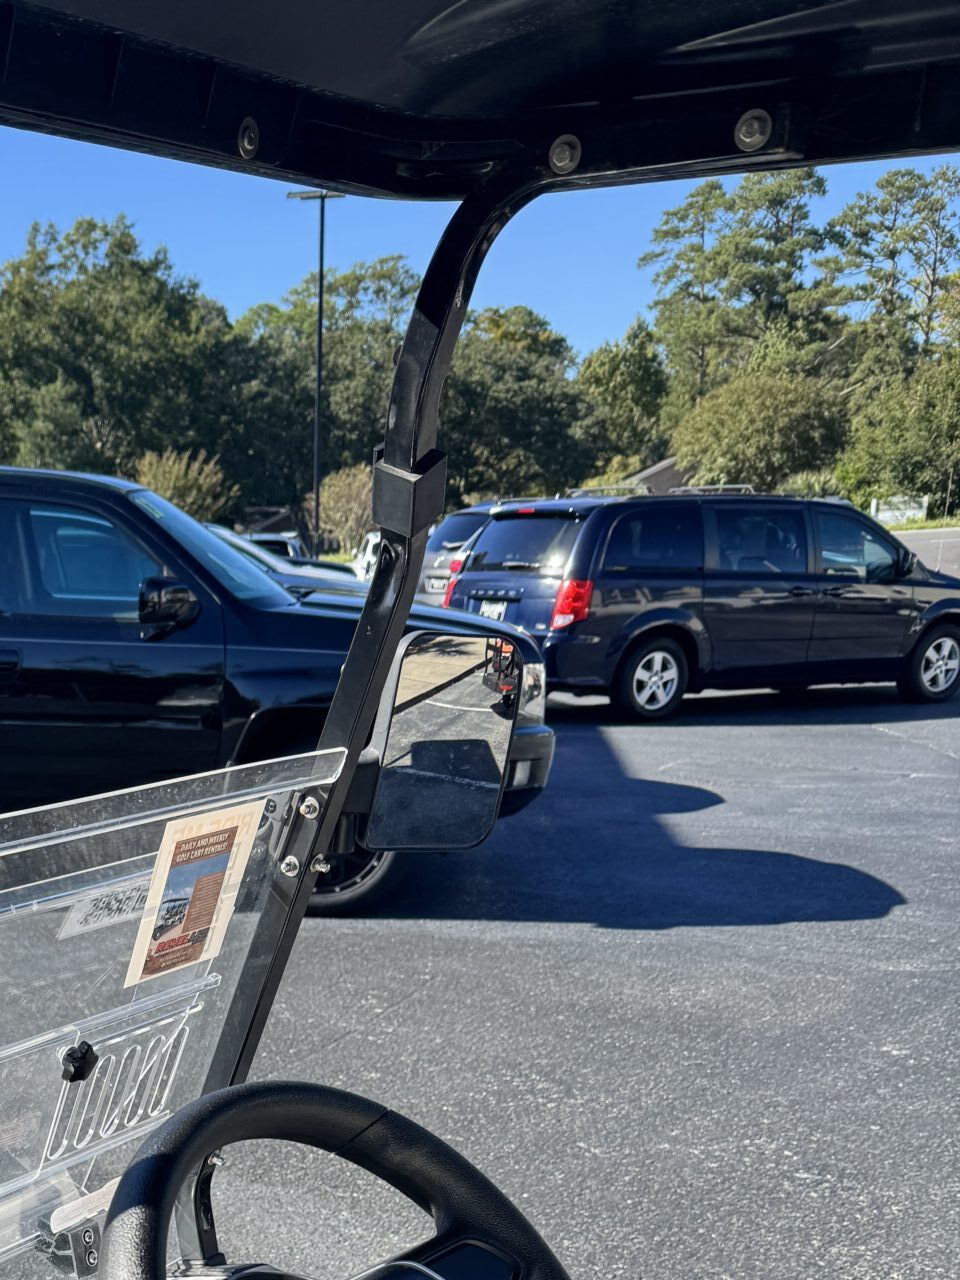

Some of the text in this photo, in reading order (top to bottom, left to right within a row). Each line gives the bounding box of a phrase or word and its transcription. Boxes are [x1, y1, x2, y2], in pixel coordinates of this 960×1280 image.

[180, 832, 230, 852] DAILY AND WEEKLY
[176, 851, 191, 863] GOLF
[190, 848, 205, 859] CART
